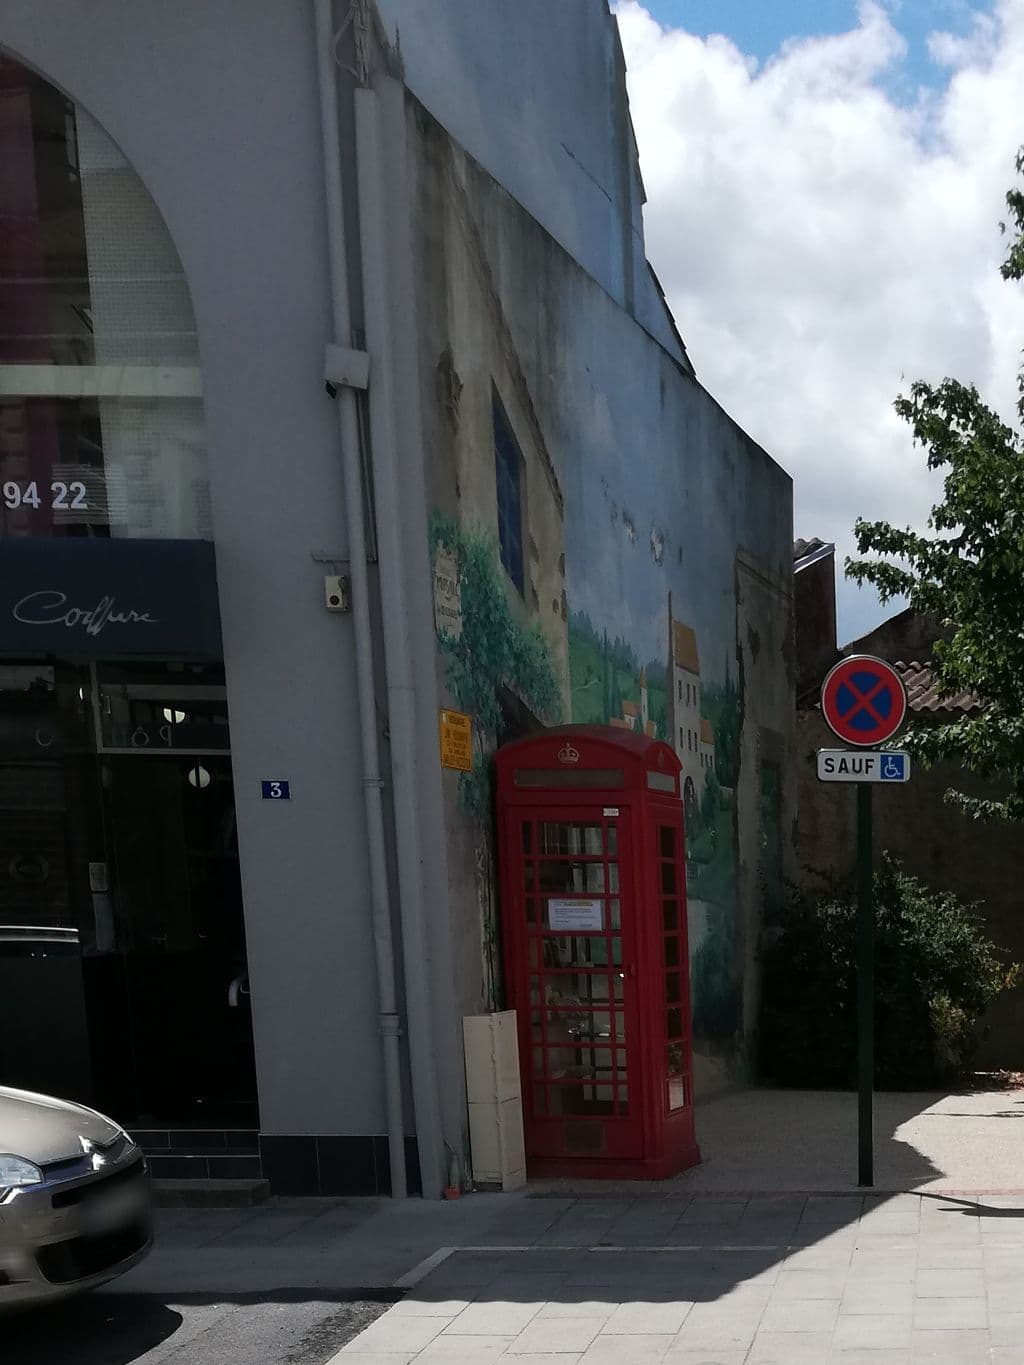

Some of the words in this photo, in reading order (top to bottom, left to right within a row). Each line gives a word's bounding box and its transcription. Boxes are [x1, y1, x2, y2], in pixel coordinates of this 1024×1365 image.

[3, 481, 41, 509] 94
[50, 481, 88, 509] 22
[13, 591, 160, 635] Coiffure
[824, 757, 875, 775] SAUF
[270, 782, 282, 798] 3
